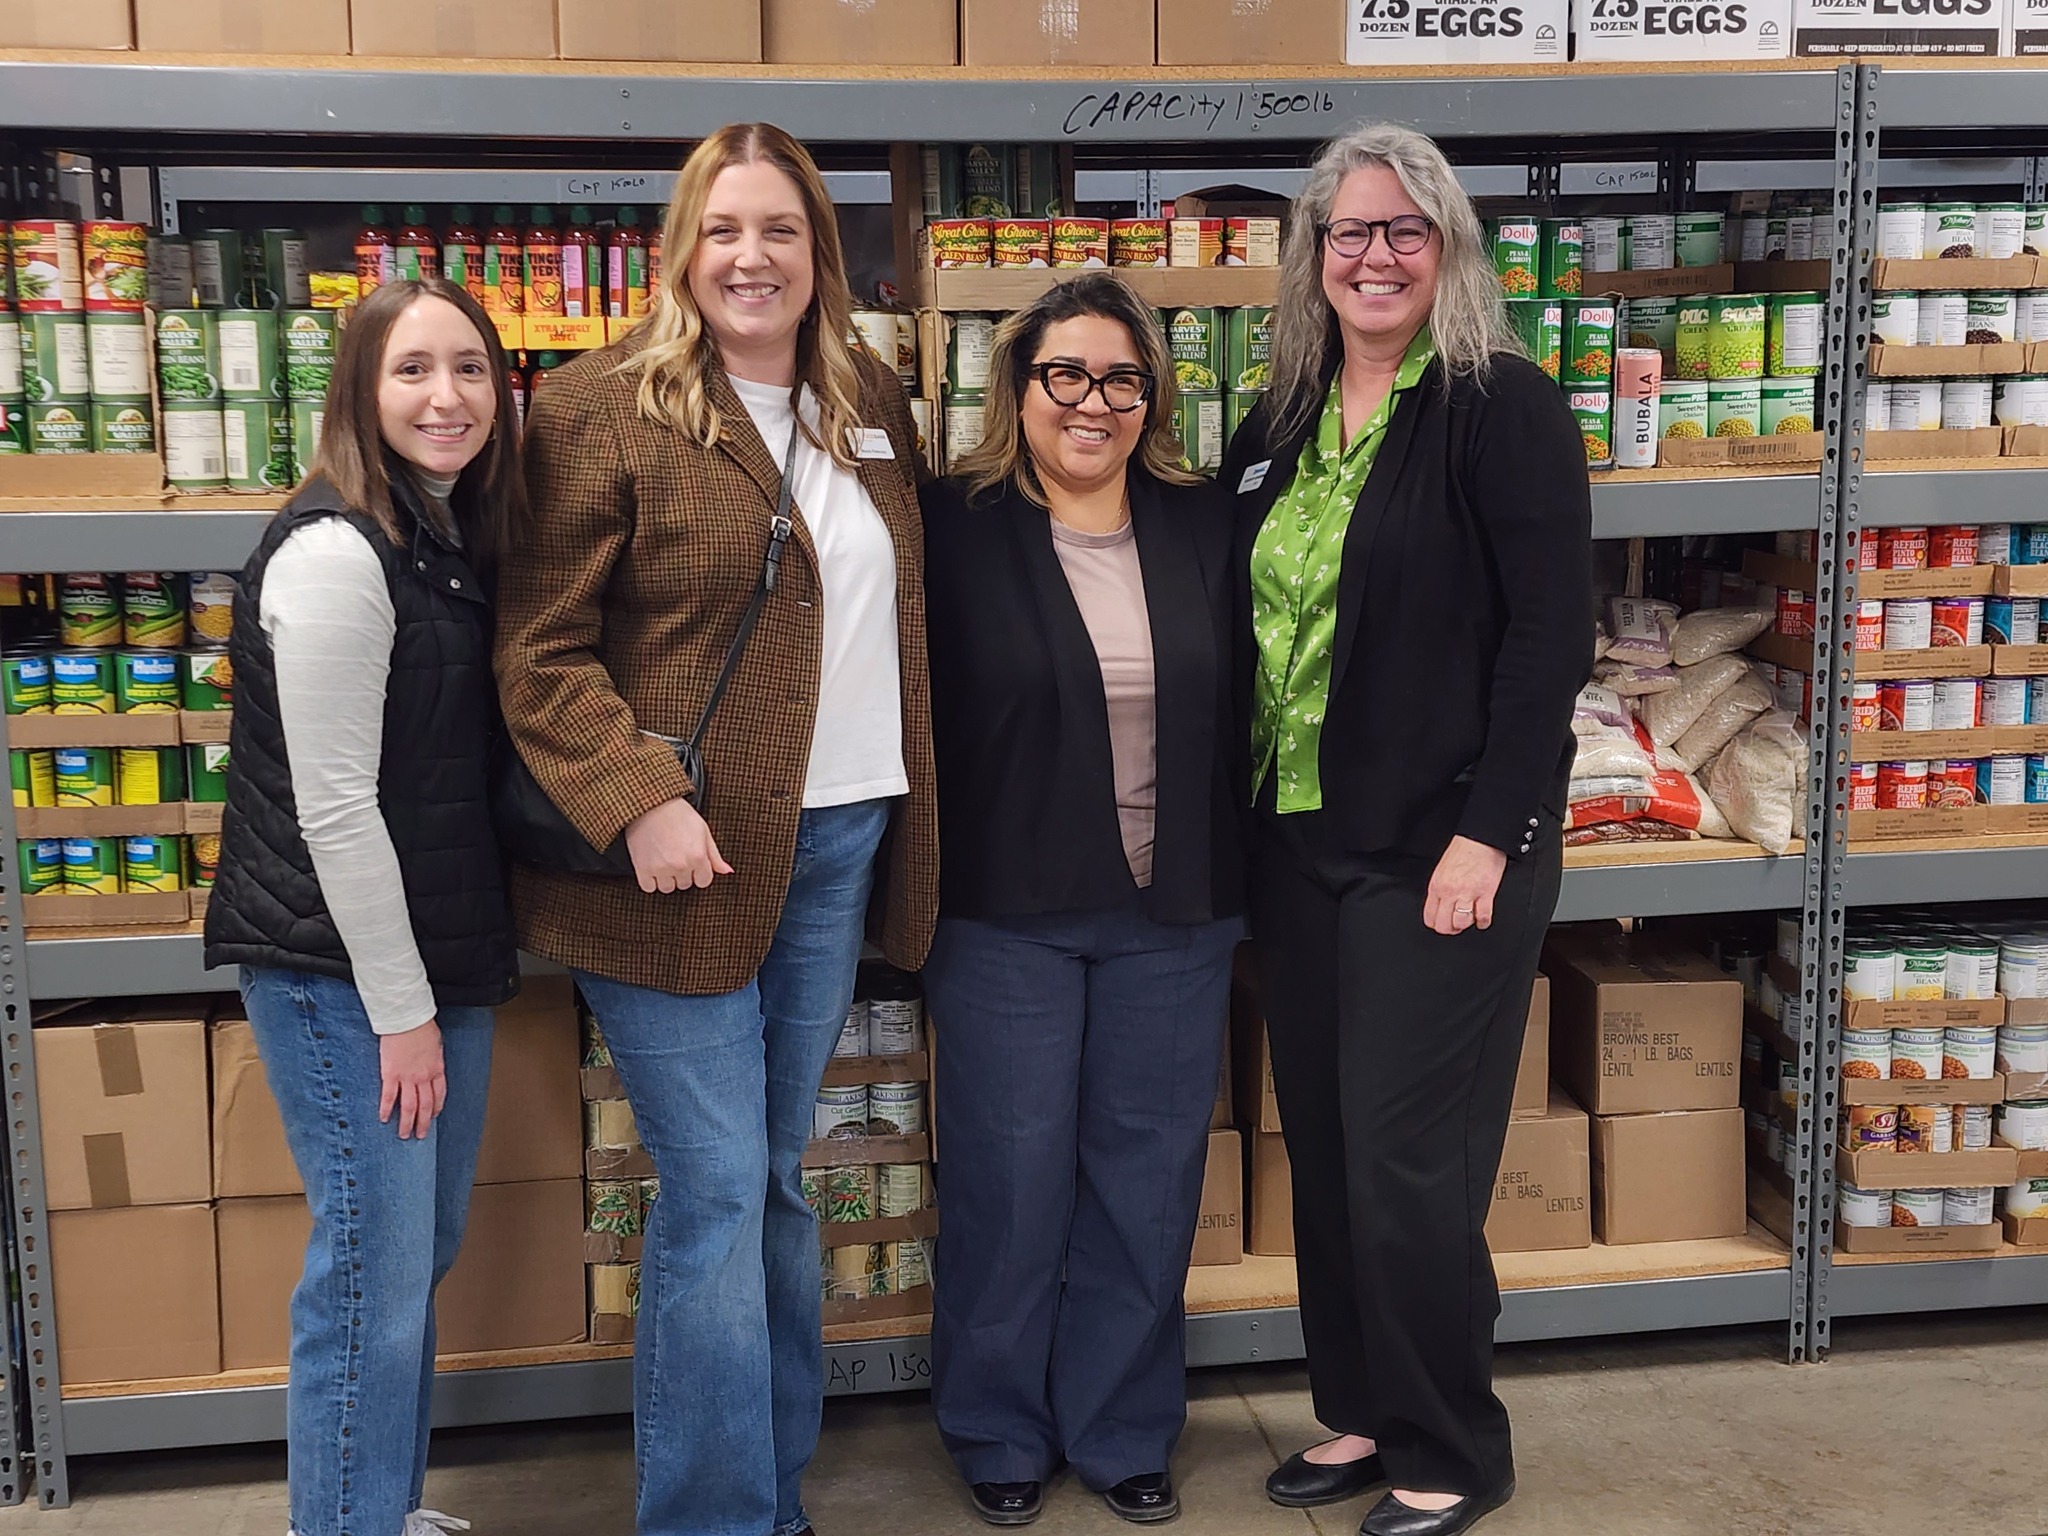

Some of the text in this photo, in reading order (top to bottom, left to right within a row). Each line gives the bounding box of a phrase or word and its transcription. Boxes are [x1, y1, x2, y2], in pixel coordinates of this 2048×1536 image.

[1811, 0, 1867, 9] DOZEN
[1415, 7, 1524, 37] EGGS
[1644, 4, 1748, 36] EGGS
[1359, 22, 1410, 33] DOZEN
[1590, 21, 1639, 32] DOZEN
[1596, 172, 1624, 187] CAP
[568, 179, 600, 196] CAP
[933, 223, 961, 243] Great
[1004, 222, 1038, 238] Choice
[1062, 221, 1095, 237] Choice
[1131, 222, 1165, 238] Choice
[1562, 229, 1582, 240] Dol
[1502, 227, 1535, 243] Dolly
[528, 253, 561, 264] TINGL
[940, 251, 988, 262] GREEN BEANS
[1005, 252, 1031, 262] BEANS
[1063, 250, 1087, 261] BEANS
[1133, 251, 1157, 261] BEANS
[1641, 307, 1667, 315] PRIDE
[1581, 310, 1613, 325] Dolly
[534, 324, 591, 333] XTRA TINGLY
[1172, 344, 1200, 352] GETABLE
[1182, 351, 1207, 359] BLEND
[1573, 395, 1607, 410] Dolly
[1636, 373, 1653, 443] BUBALA
[1893, 539, 1925, 550] REFRIED
[1892, 549, 1915, 558] PINTO
[1952, 547, 1972, 556] PINTO
[1892, 557, 1917, 565] BEANS
[1952, 555, 1974, 563] BEANS
[1852, 705, 1874, 716] FRIED
[1897, 793, 1918, 802] PINTO
[1896, 801, 1922, 809] BEANS
[1603, 1033, 1679, 1045] BROWNS BEST
[1602, 1047, 1613, 1061] 24
[1667, 1046, 1693, 1061] BAGS
[1602, 1062, 1733, 1077] LENTIL LENTILS
[1502, 1171, 1529, 1184] BEST
[1517, 1184, 1544, 1199] BAGS
[1546, 1196, 1584, 1213] LENTILS
[1198, 1213, 1236, 1229] LENTILS
[828, 1352, 931, 1391] AP 150
